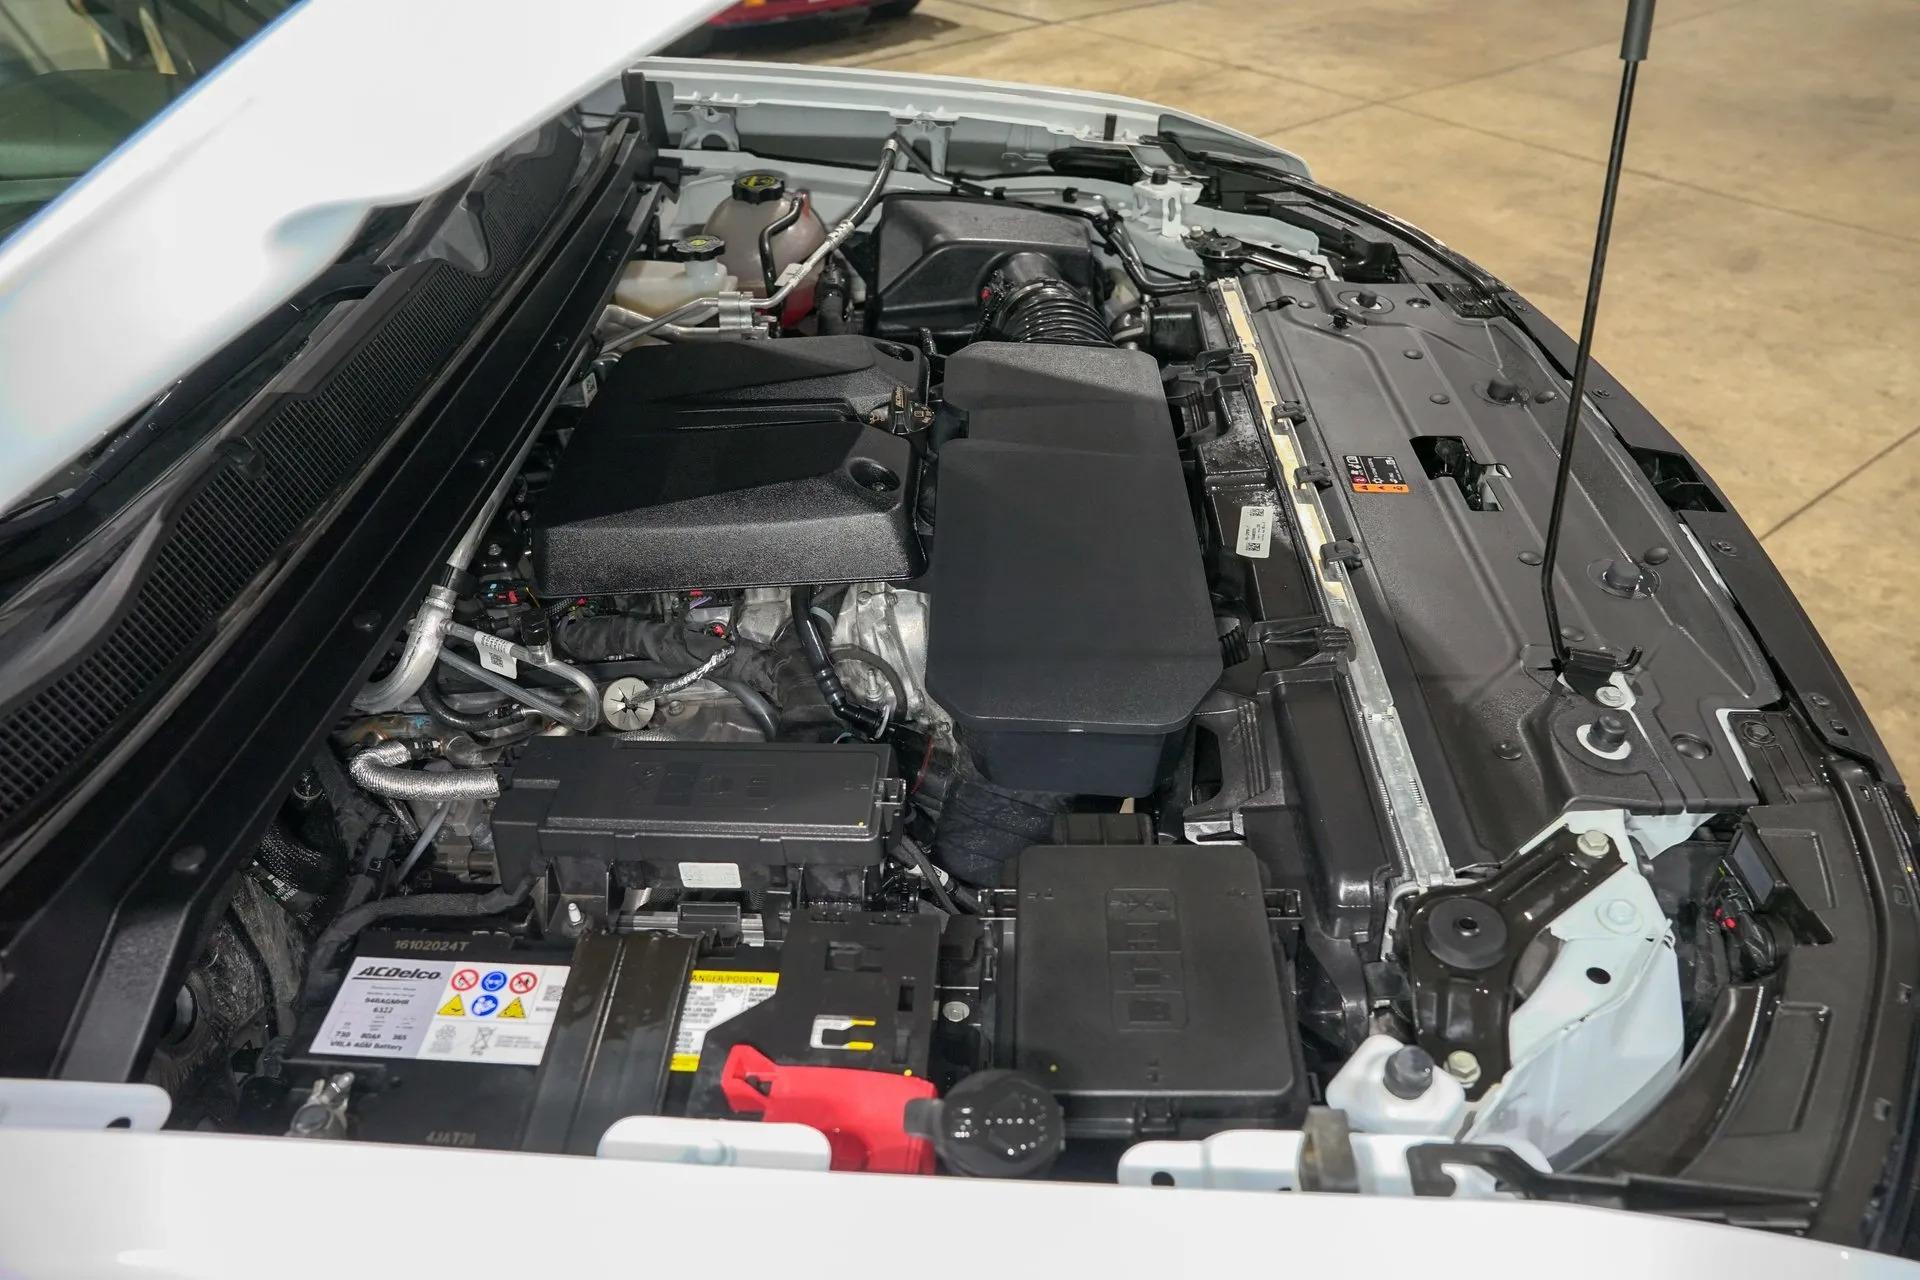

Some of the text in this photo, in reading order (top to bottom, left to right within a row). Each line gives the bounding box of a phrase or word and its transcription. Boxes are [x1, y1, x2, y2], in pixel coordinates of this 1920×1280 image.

[395, 940, 469, 951] 16102024T
[358, 966, 441, 979] ACDelco
[691, 974, 764, 983] ANGER/POISON
